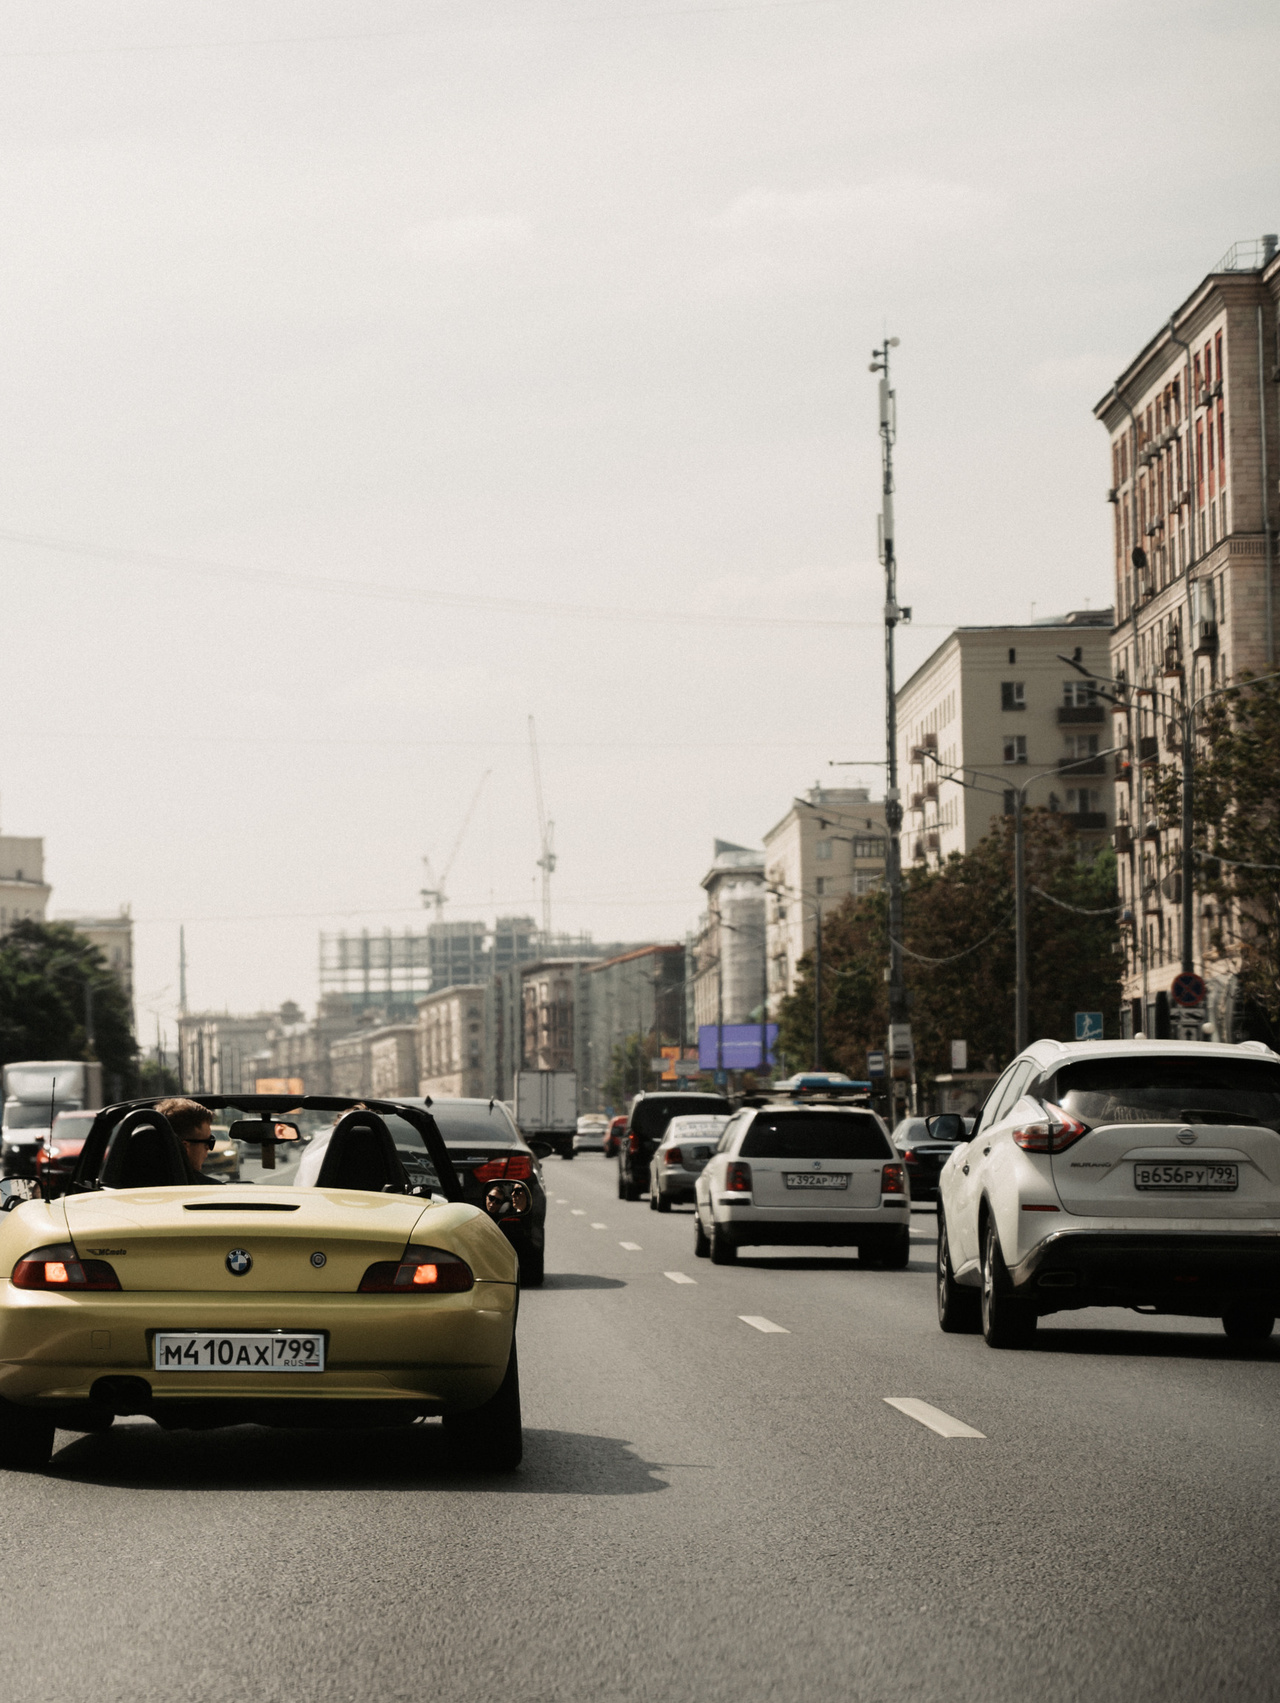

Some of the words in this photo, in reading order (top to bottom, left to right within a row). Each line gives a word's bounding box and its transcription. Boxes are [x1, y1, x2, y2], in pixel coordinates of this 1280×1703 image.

[790, 1175, 828, 1185] У392АР
[1141, 1167, 1205, 1184] В656РУ
[1208, 1167, 1233, 1180] 799
[164, 1339, 270, 1366] М410АХ
[275, 1339, 316, 1360] 799
[284, 1359, 304, 1367] RUS
